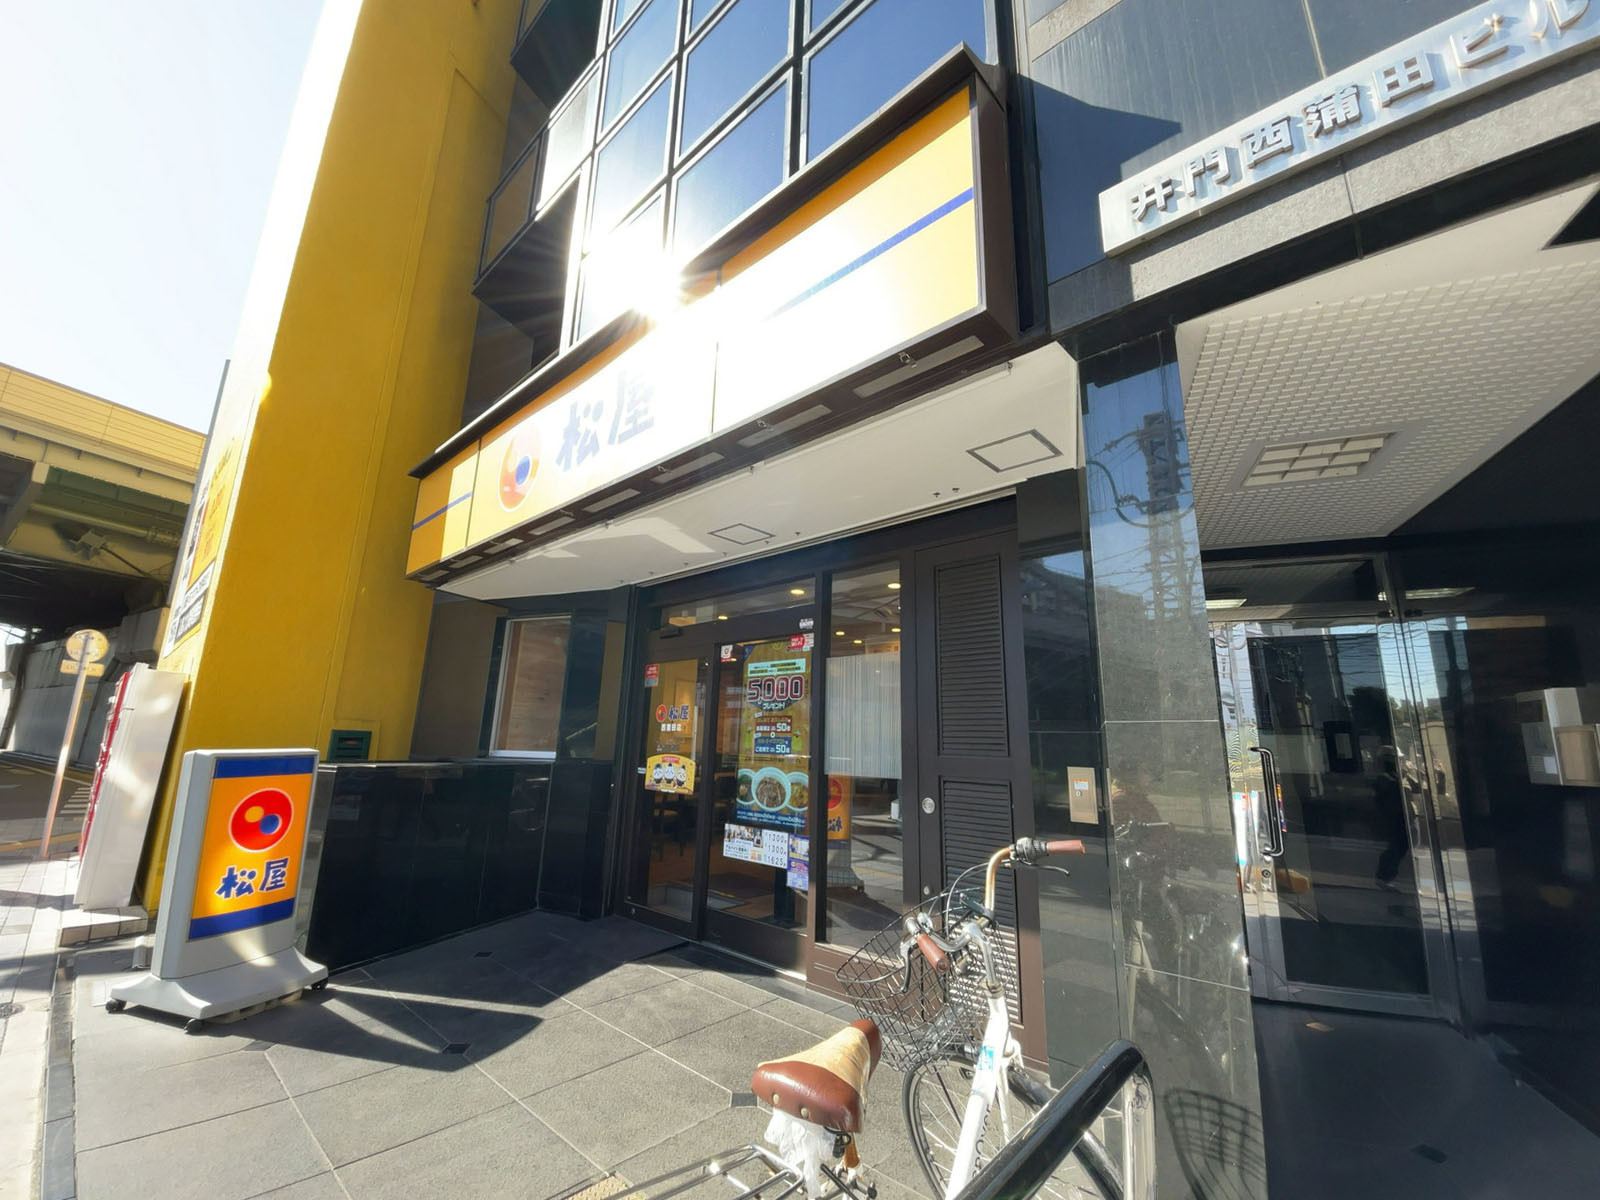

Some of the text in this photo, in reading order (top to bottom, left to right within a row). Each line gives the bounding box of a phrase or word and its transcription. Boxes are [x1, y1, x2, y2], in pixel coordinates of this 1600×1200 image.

[1130, 0, 1590, 222] 井門西蒲田ビル
[554, 370, 656, 472] 松屋
[215, 857, 290, 900] 松屋
